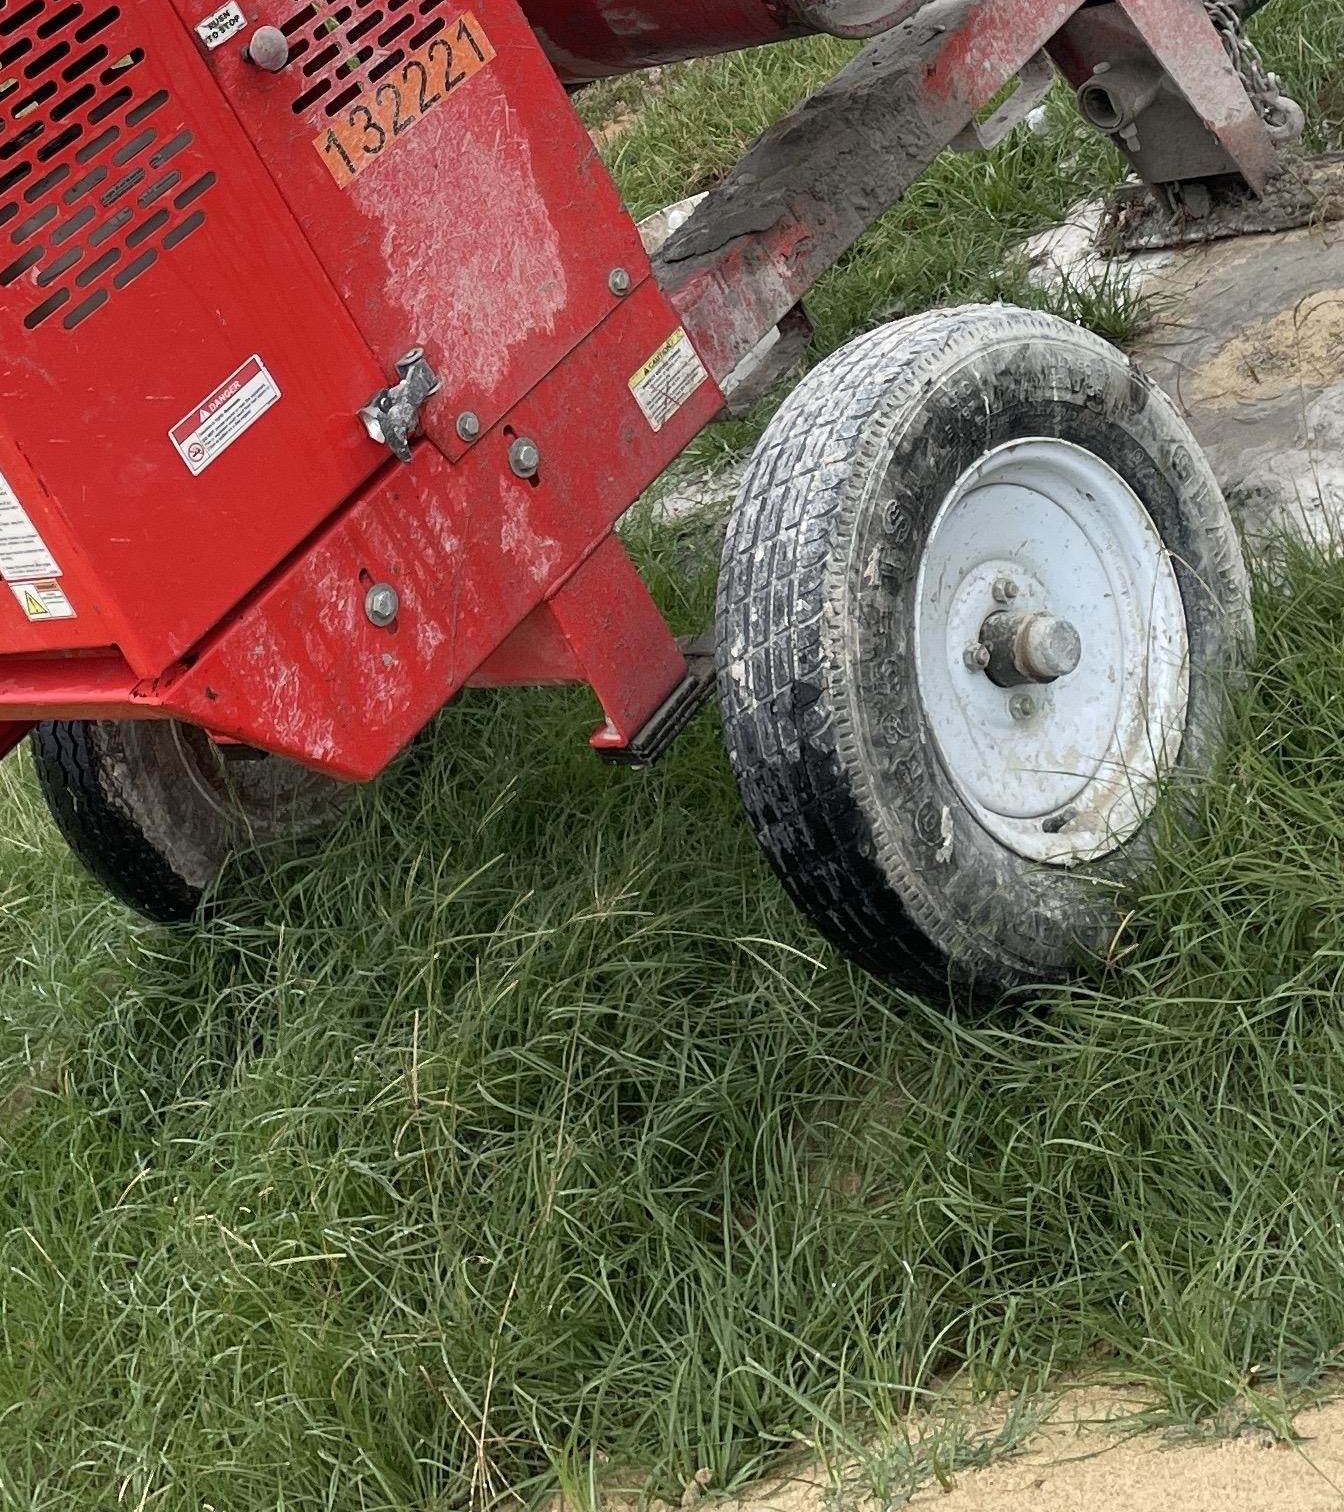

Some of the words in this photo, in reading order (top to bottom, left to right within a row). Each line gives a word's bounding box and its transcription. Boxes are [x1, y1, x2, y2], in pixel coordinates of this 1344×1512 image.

[206, 31, 219, 42] TO
[218, 15, 240, 33] STOP
[324, 19, 485, 174] 132221
[647, 342, 673, 369] CAUTION
[208, 380, 242, 413] DANGER
